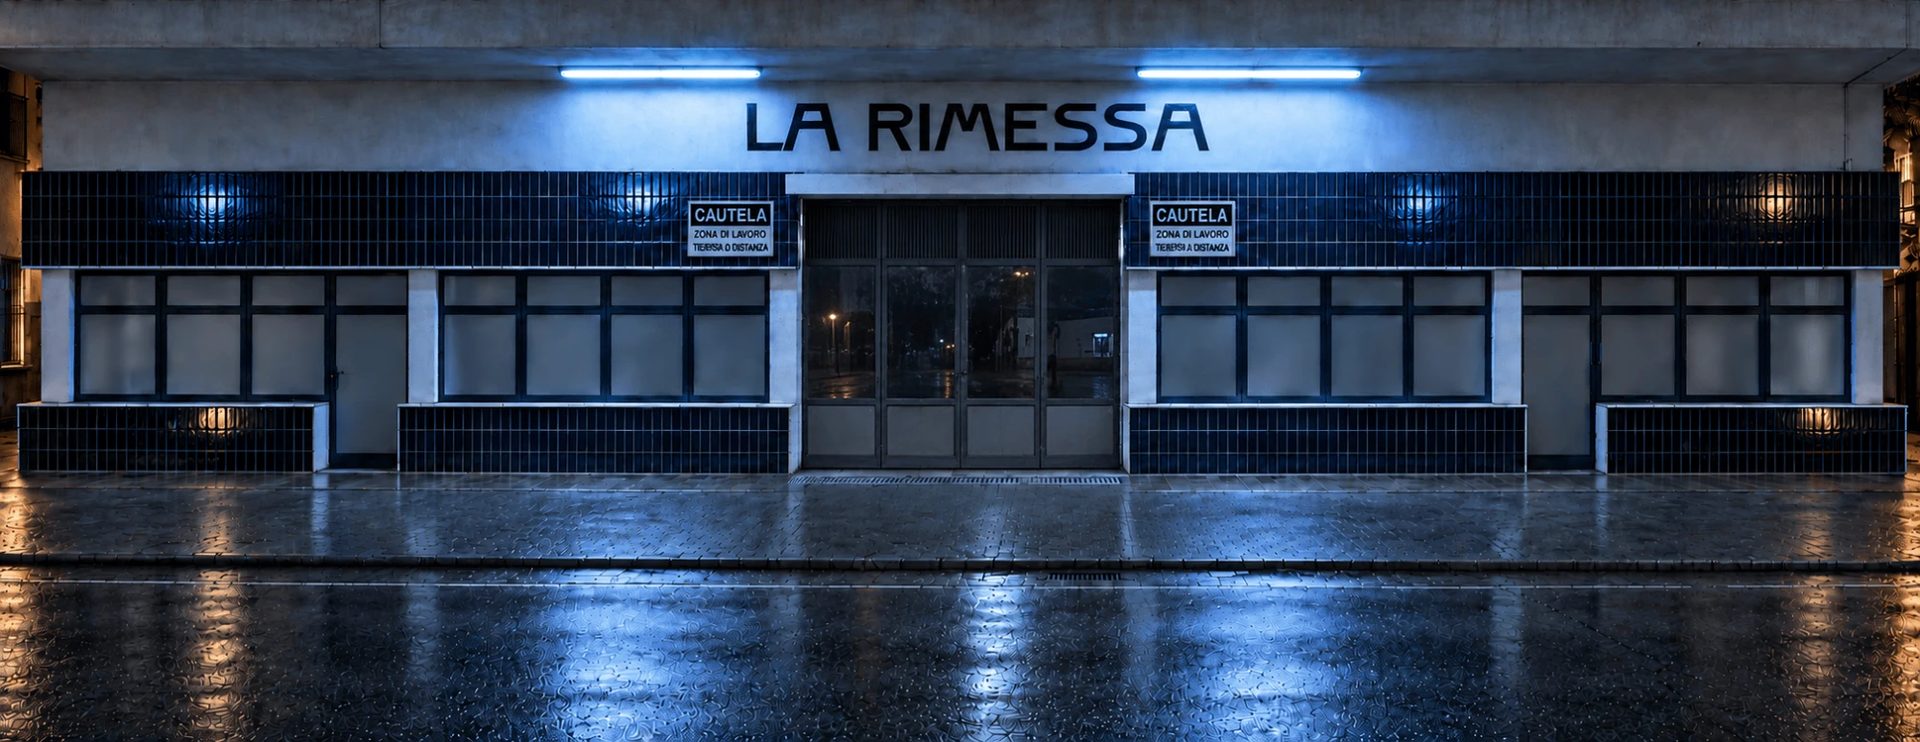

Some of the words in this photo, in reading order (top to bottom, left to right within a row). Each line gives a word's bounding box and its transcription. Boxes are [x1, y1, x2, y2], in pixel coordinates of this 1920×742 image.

[746, 102, 841, 152] LA
[868, 102, 1210, 152] RIMESSA
[694, 207, 767, 223] CAUTELA
[1156, 207, 1228, 223] CAUTELA
[694, 229, 718, 239] ZONA
[720, 229, 729, 239] DI
[732, 229, 767, 239] LAVORO
[1156, 230, 1180, 239] ZONA
[1182, 230, 1191, 239] DI
[1194, 230, 1229, 239] LAVORO
[732, 243, 769, 252] DISTANZA
[1186, 243, 1193, 252] A
[1194, 243, 1230, 252] DISTANZA
